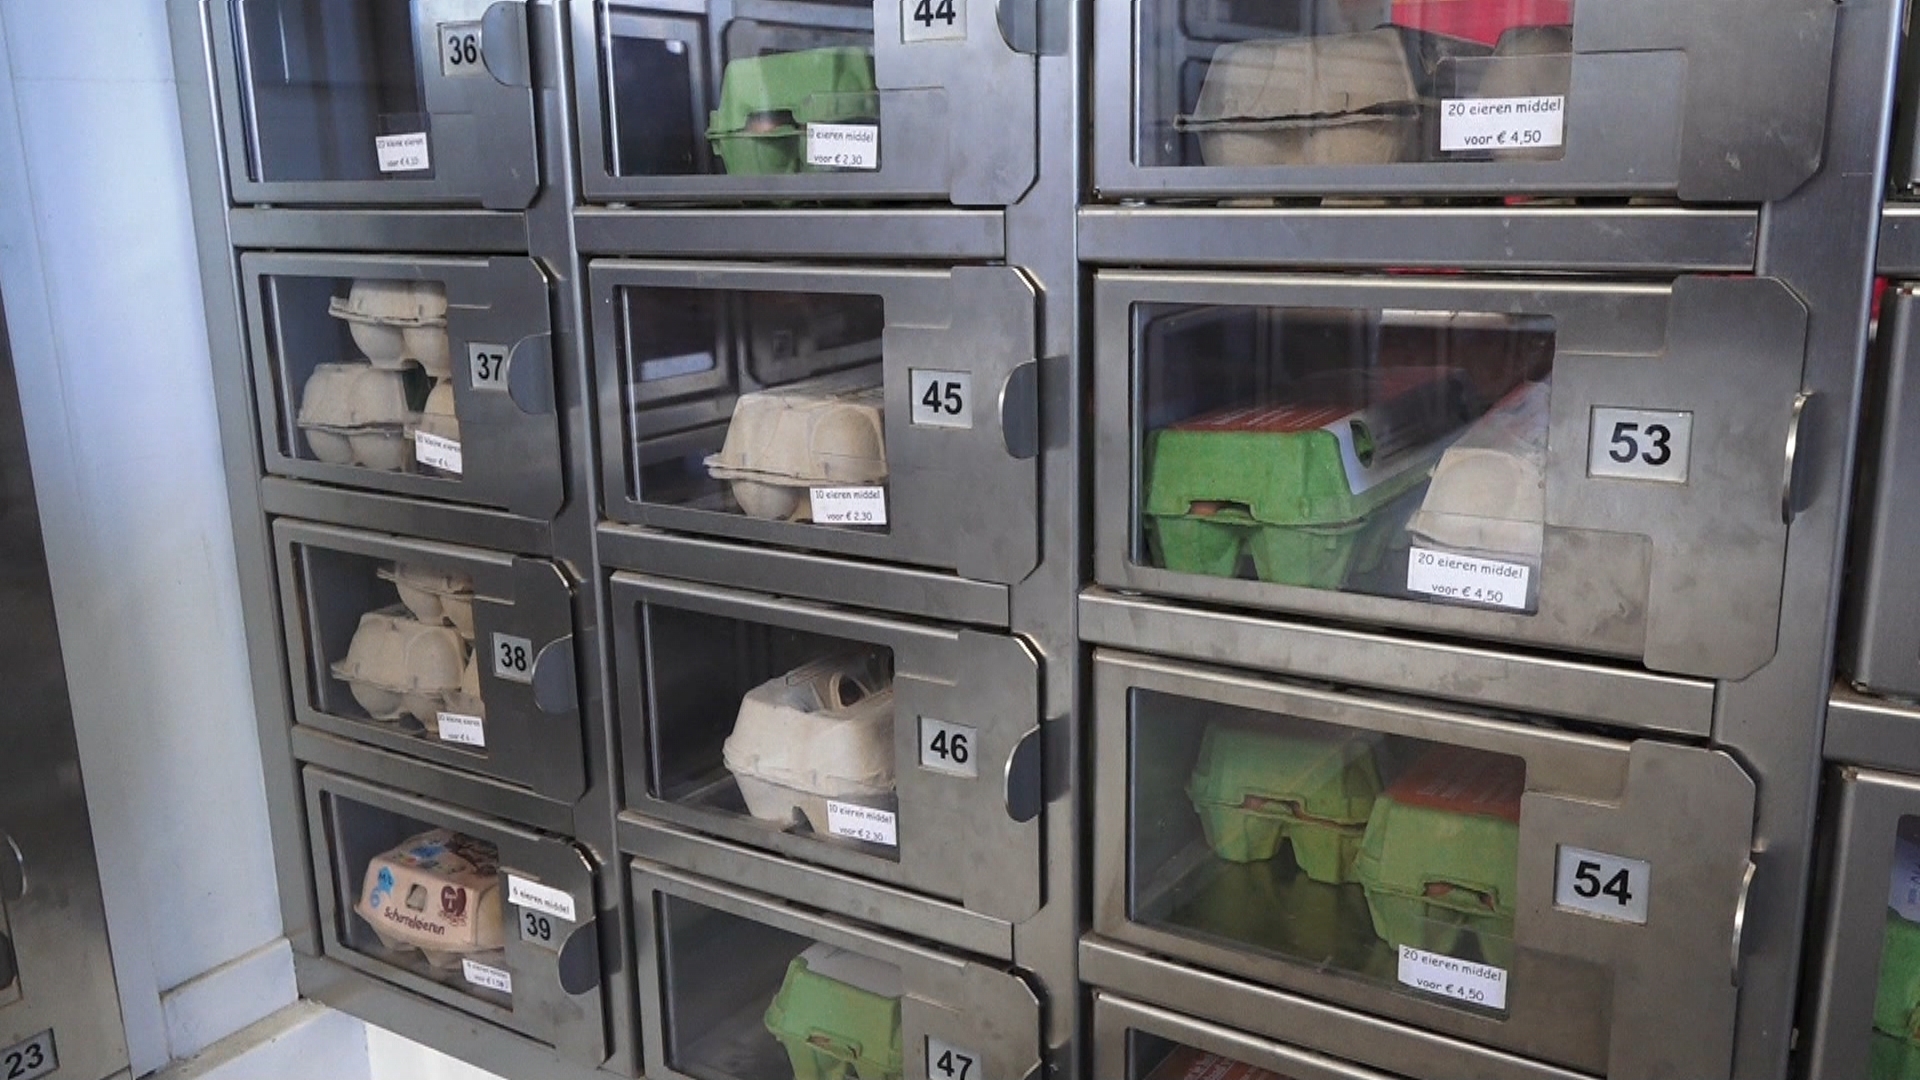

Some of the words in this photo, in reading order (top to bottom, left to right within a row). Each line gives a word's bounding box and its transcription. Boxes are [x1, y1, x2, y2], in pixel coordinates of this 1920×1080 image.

[914, 0, 956, 27] 44
[448, 33, 477, 65] 36
[1447, 102, 1465, 116] 20
[1468, 101, 1512, 115] eieren
[1515, 98, 1561, 113] middel
[816, 131, 844, 140] eieren
[845, 131, 874, 142] middel
[1464, 134, 1493, 145] voor
[1496, 130, 1506, 144] €
[1510, 129, 1542, 145] 4,50
[814, 154, 832, 163] voor
[834, 153, 842, 163] €
[477, 352, 503, 381] 37
[922, 380, 962, 415] 45
[1609, 422, 1671, 465] 53
[815, 490, 824, 499] 10
[826, 490, 852, 500] eieren
[853, 489, 880, 499] middel
[826, 513, 843, 521] voor
[846, 511, 852, 521] €
[1418, 552, 1434, 565] 20
[1437, 557, 1477, 572] eieren
[1480, 565, 1523, 579] middel
[1431, 583, 1458, 595] voor
[1461, 586, 1471, 597] €
[500, 642, 527, 672] 38
[930, 729, 968, 764] 46
[829, 803, 838, 813] 10
[839, 807, 864, 819] eieren
[866, 813, 892, 824] middel
[857, 828, 864, 837] €
[1573, 860, 1632, 906] 54
[520, 889, 543, 905] eieren
[525, 912, 551, 941] 39
[1403, 948, 1418, 961] 20
[1421, 954, 1458, 972] eieren
[1461, 965, 1501, 981] middel
[1416, 978, 1441, 990] voor
[1445, 983, 1454, 993] €
[1457, 986, 1484, 1001] 4,50
[4, 1043, 44, 1080] 23
[937, 1050, 973, 1080] 47
